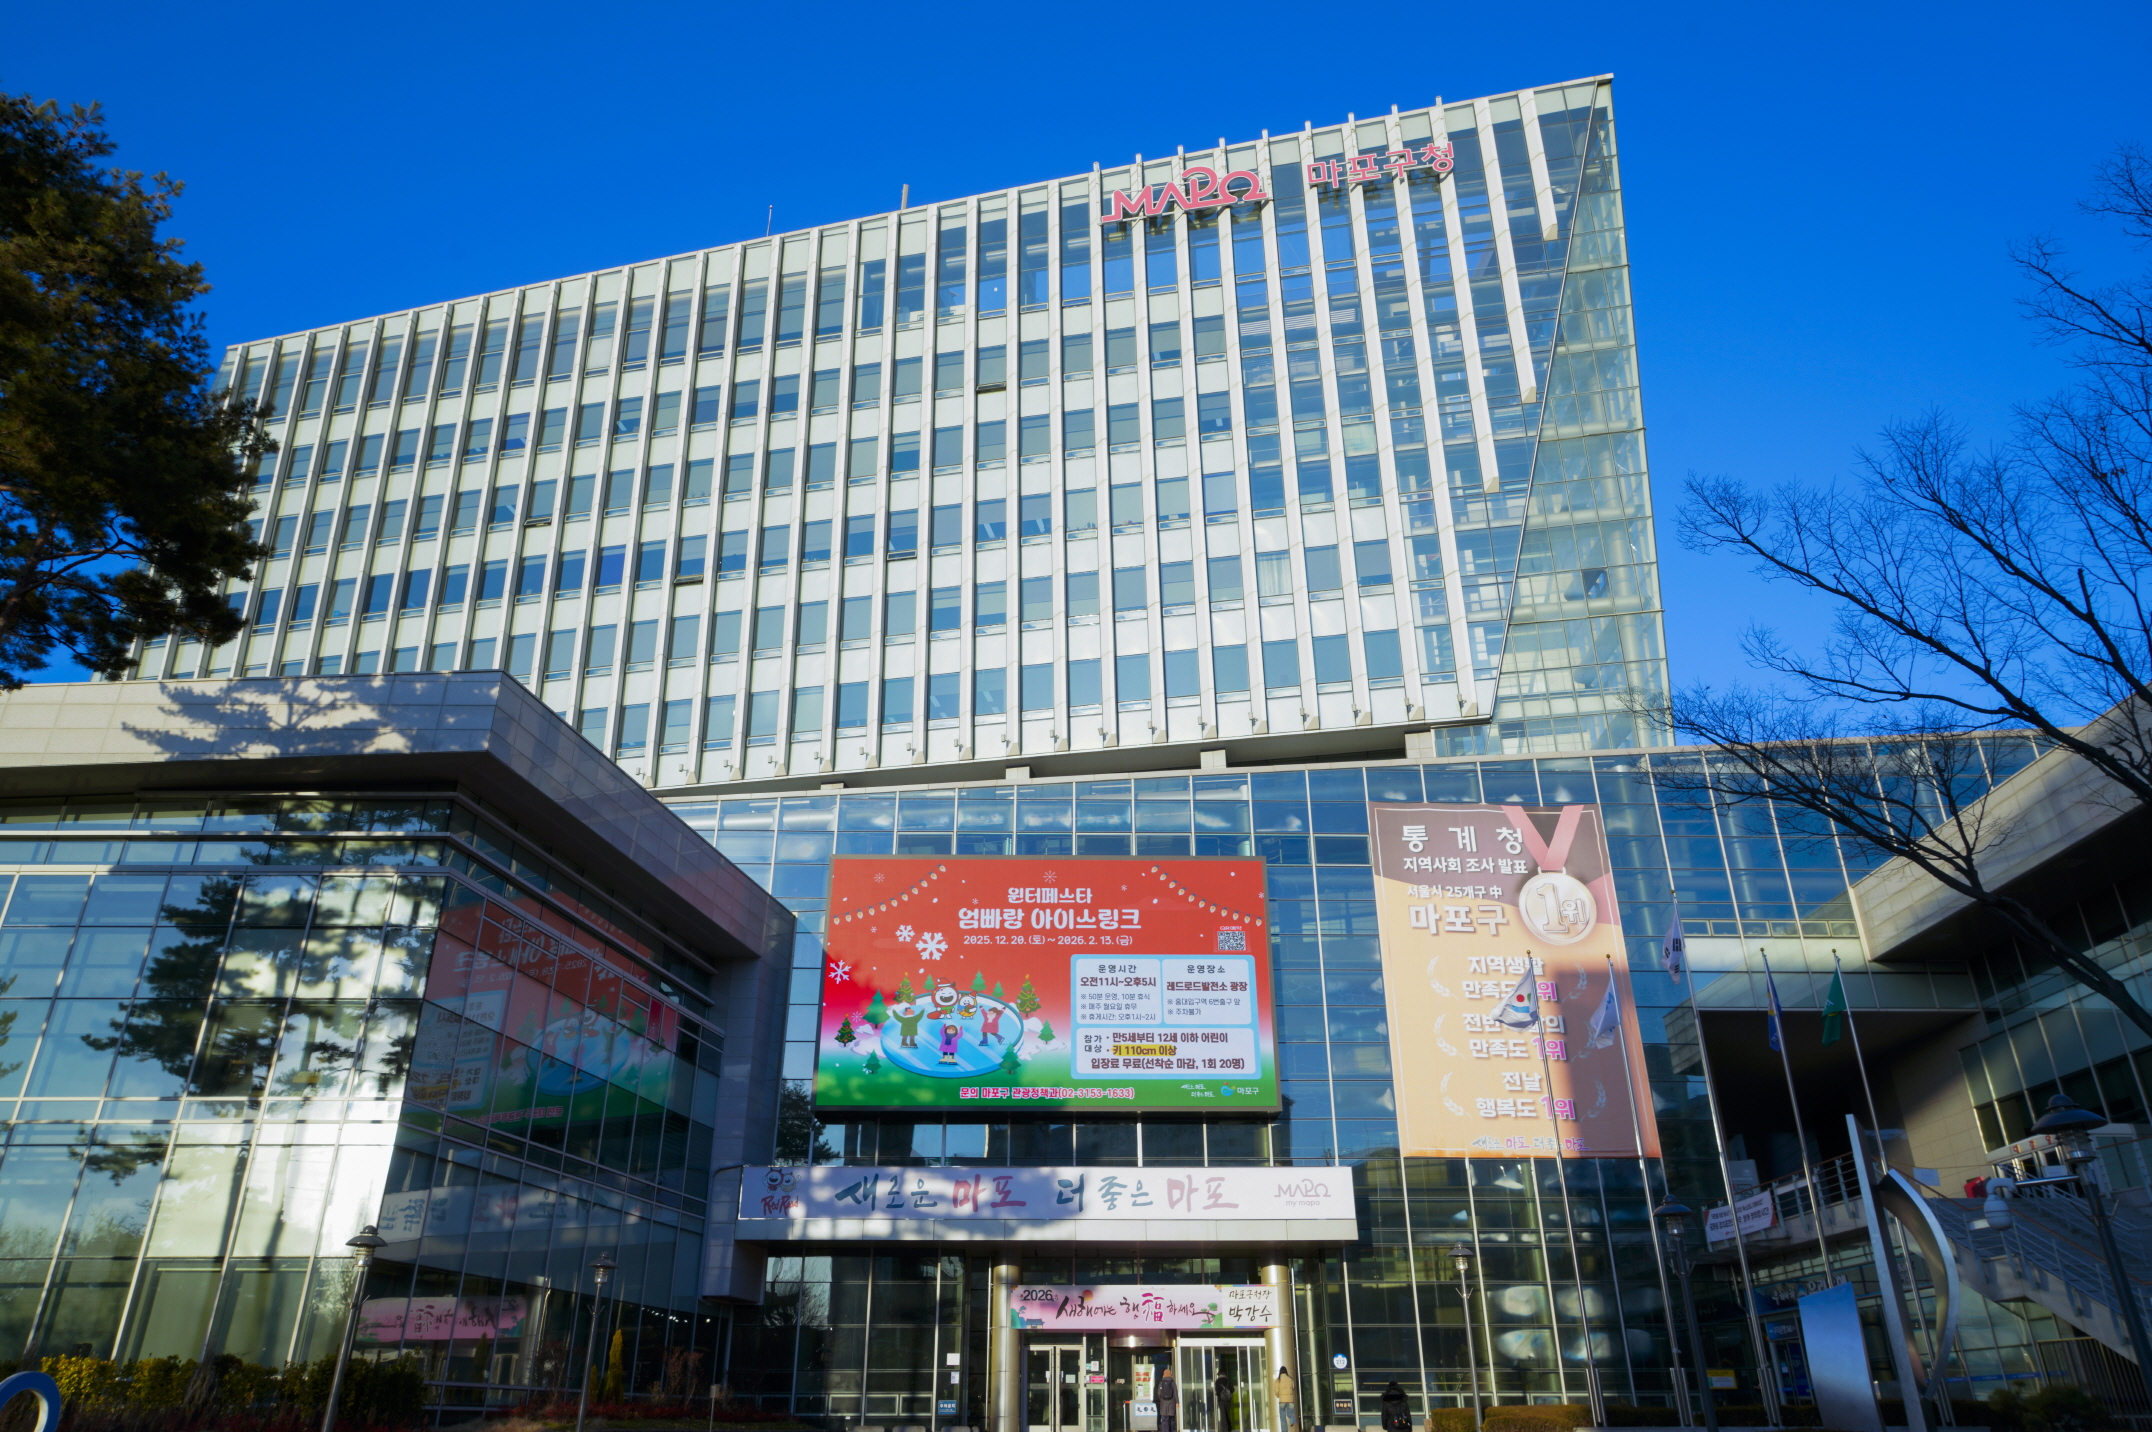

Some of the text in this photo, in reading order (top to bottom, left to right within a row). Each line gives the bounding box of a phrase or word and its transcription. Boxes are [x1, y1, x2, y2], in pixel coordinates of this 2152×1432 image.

[1307, 142, 1454, 189] 마포구청
[1101, 166, 1267, 223] MAPO
[1403, 856, 1528, 874] 지역사회 조사 발표
[1007, 887, 1093, 904] 윈터페스타
[1406, 884, 1502, 899] 서울시 25개구 中
[1536, 883, 1586, 932] 1위
[958, 908, 1142, 930] 엄빠랑 아이스링크
[1408, 902, 1509, 936] 마포구
[1098, 965, 1137, 974] 운영시간
[1187, 965, 1226, 974] 운영장소
[1080, 977, 1156, 987] 오전11시~오후5시
[1166, 982, 1248, 991] 레드로드발전소 광장
[1112, 1033, 1228, 1043] 만5세부터 12세 이하 어린이
[1112, 1046, 1177, 1056] 키 110cm 이상
[1469, 1036, 1566, 1060] 만족도 1위
[1091, 1059, 1244, 1070] 입장료 무료(선착순 마감, 1회 20명)
[1502, 1072, 1542, 1091] 전날
[960, 1087, 1135, 1099] 문의 마포구 관광정책과(02-3153-1633)
[1475, 1095, 1576, 1119] 행복도 1위
[1505, 1135, 1531, 1151] 마포
[834, 1174, 1239, 1213] 새로운 마포 더 좋은 마포
[1274, 1178, 1332, 1198] MAPO
[1023, 1289, 1053, 1301] 2026
[1228, 1290, 1272, 1300] 마포구청장
[1228, 1304, 1273, 1323] 박강수
